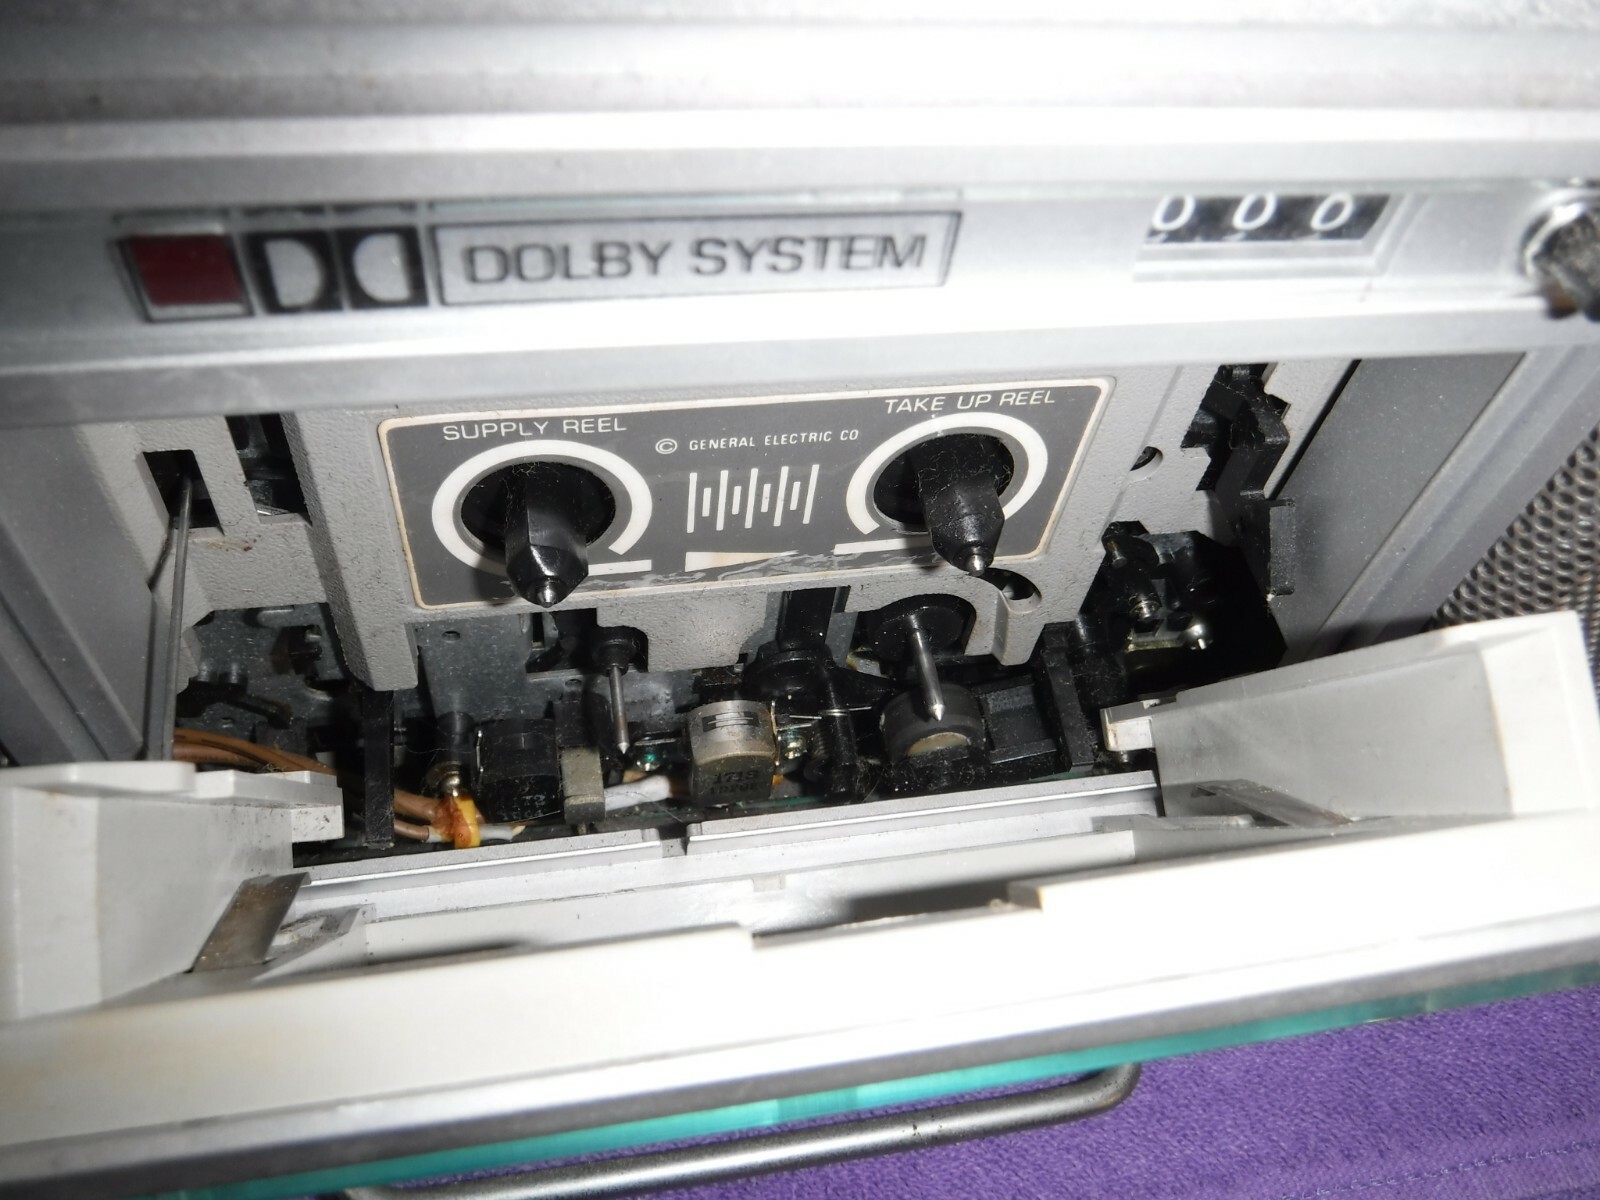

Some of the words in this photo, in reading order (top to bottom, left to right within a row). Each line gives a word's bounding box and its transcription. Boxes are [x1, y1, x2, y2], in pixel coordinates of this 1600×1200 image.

[461, 240, 674, 285] DOLBY
[688, 234, 927, 276] SYSTEM
[885, 396, 946, 414] TAKE
[957, 394, 992, 409] UP
[999, 390, 1055, 406] REEL
[443, 421, 549, 441] SUPPLY
[562, 417, 627, 434] REEL
[689, 437, 755, 451] GENERAL
[764, 431, 832, 446] ELECTRIC
[840, 429, 859, 441] CO
